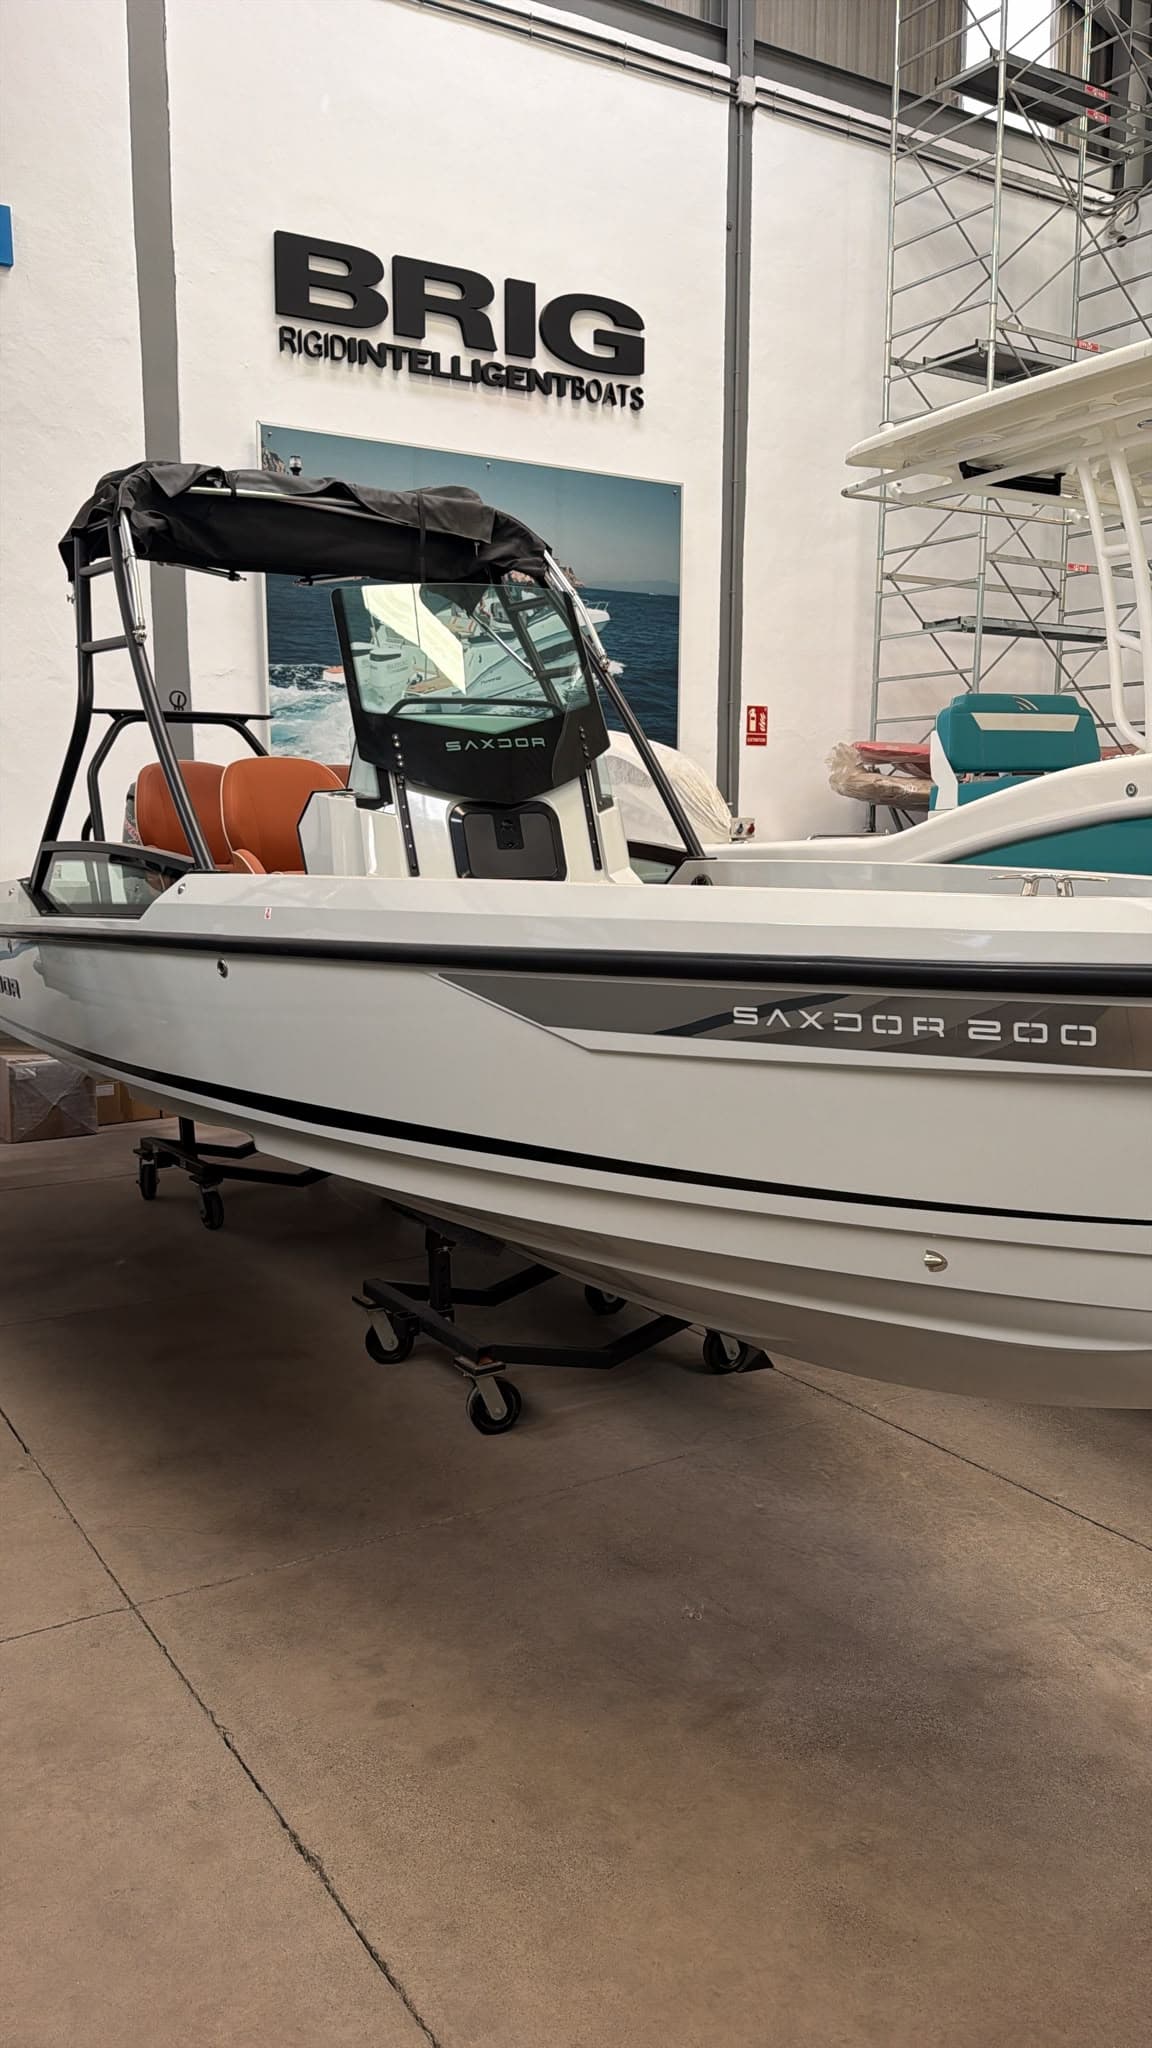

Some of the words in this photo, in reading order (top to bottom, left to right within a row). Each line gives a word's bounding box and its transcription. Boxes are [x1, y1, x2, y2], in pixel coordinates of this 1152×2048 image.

[274, 230, 645, 377] BRIG
[445, 737, 546, 752] SAXDOR
[732, 1006, 945, 1038] SAXDOR
[967, 1019, 1097, 1047] 200
